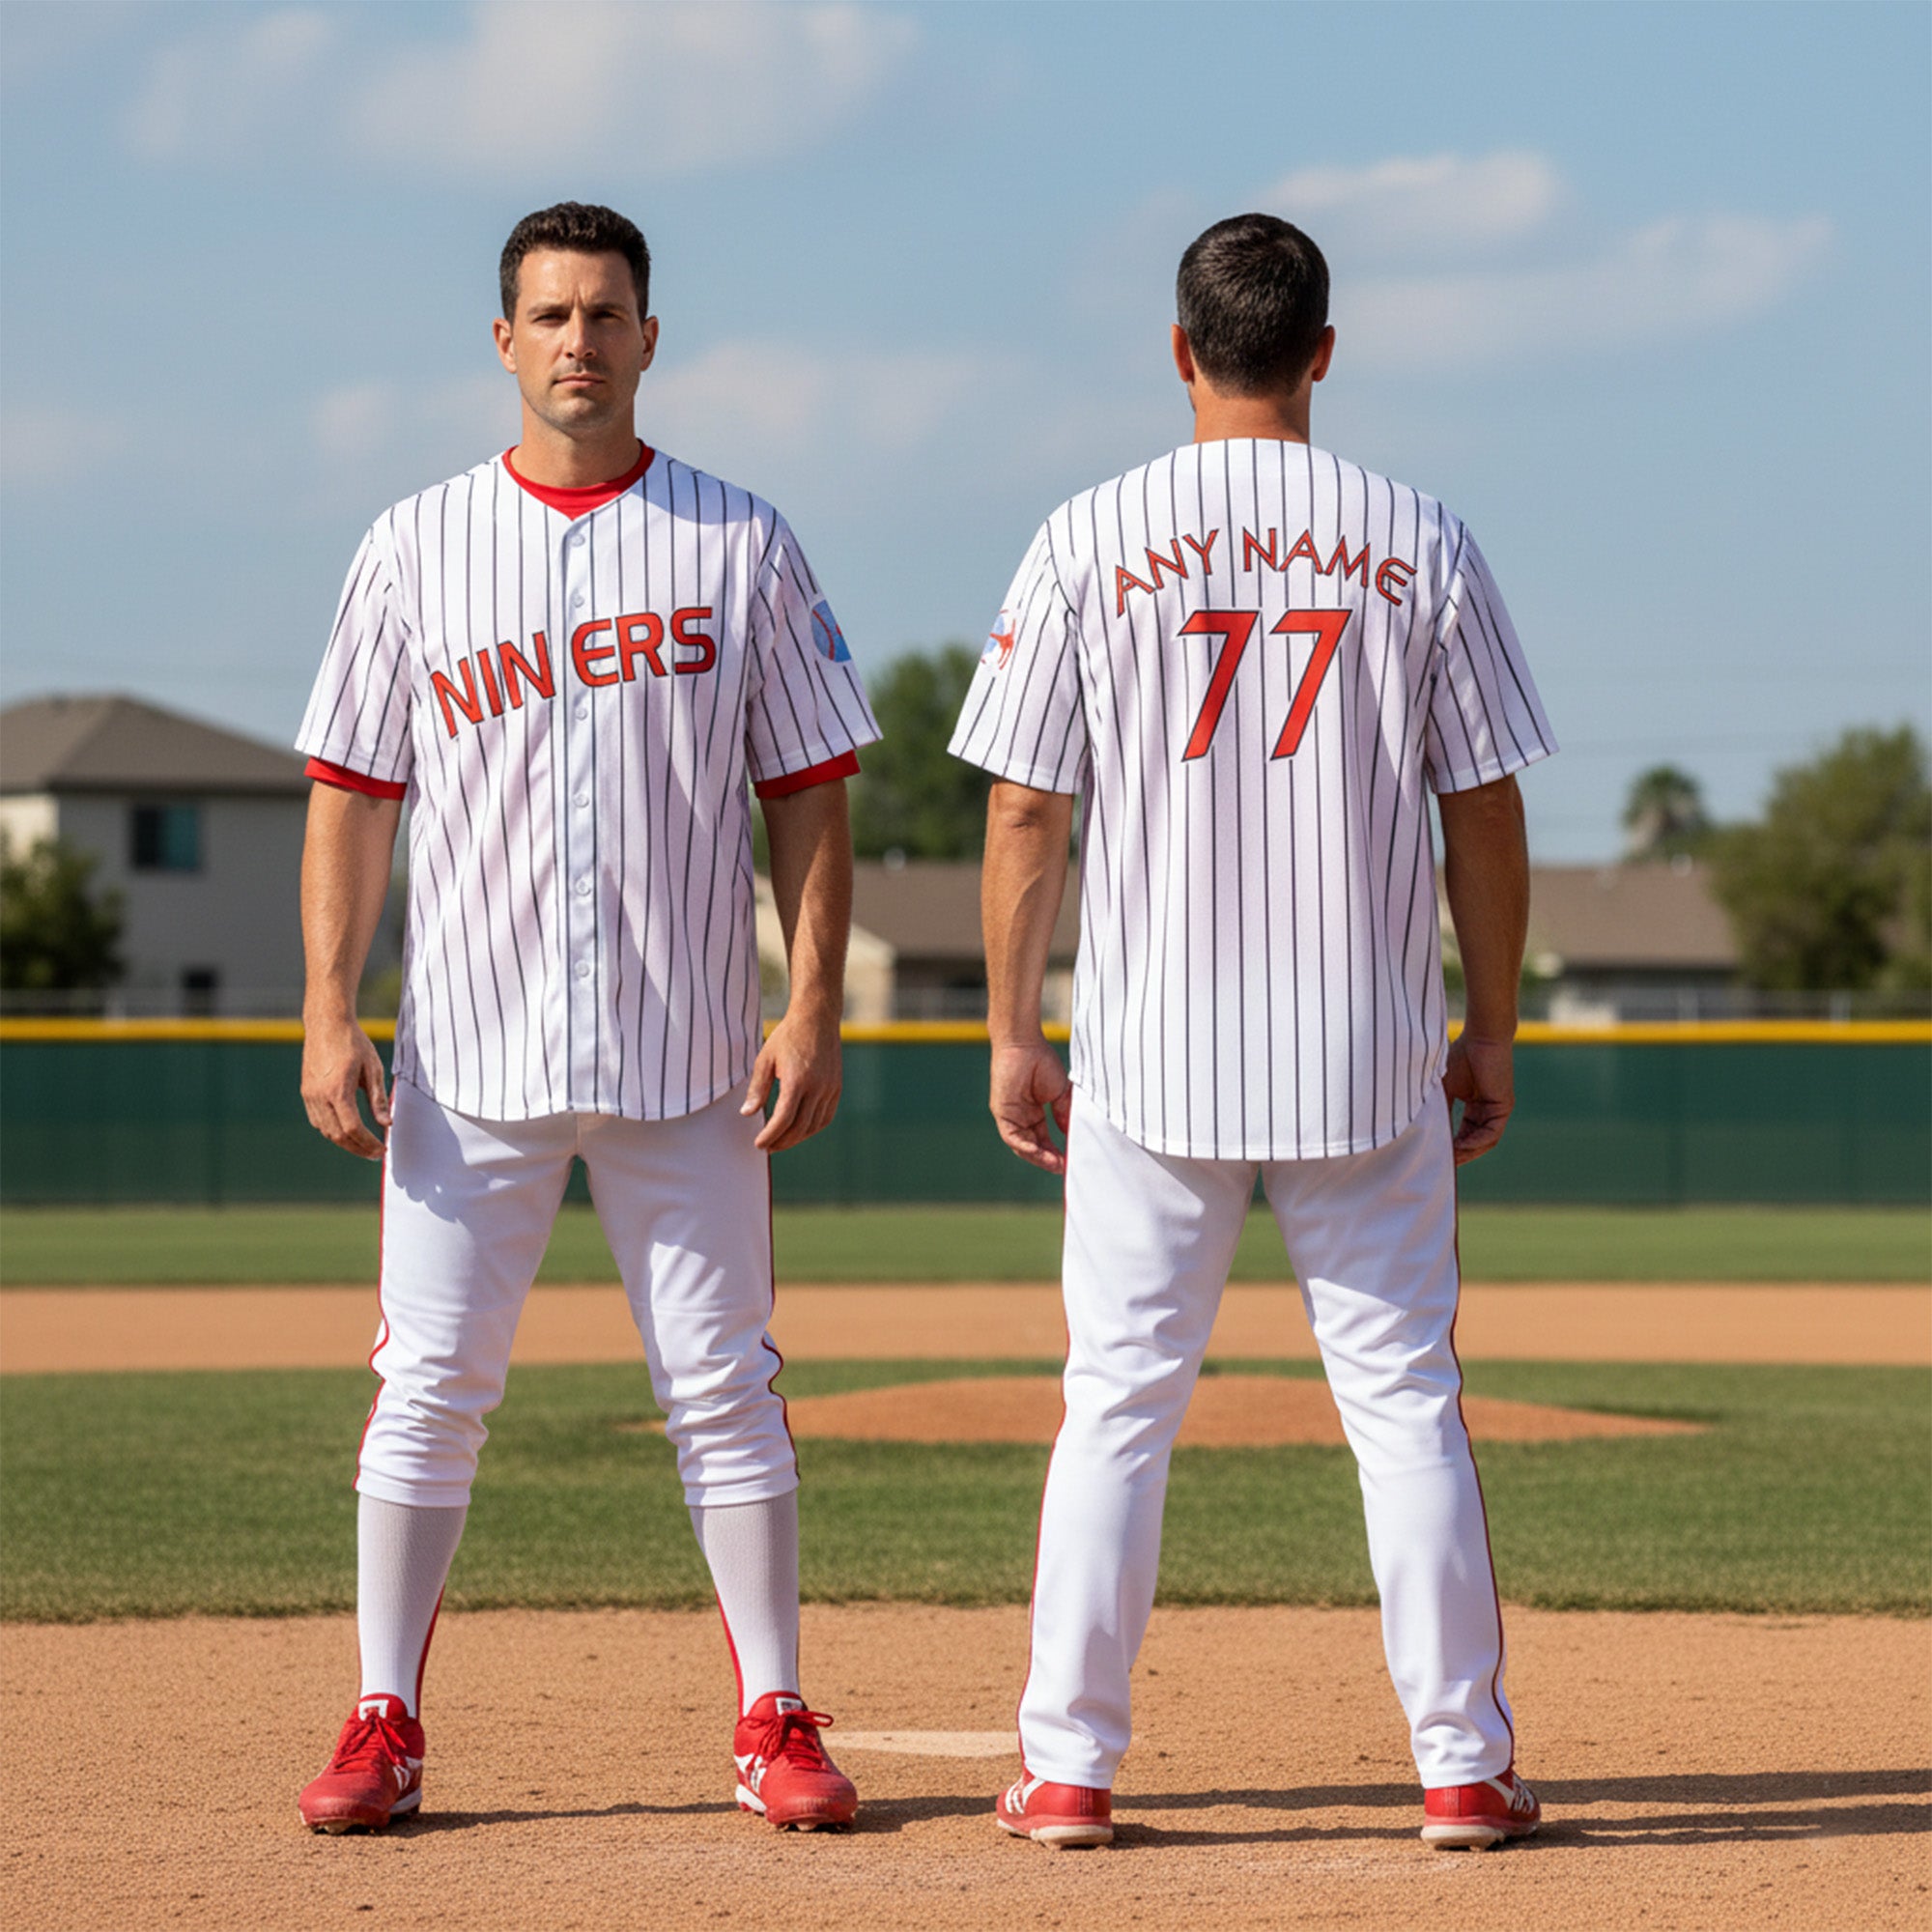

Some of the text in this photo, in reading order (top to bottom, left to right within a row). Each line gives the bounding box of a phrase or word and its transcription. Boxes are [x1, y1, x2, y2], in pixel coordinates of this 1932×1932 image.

[1115, 526, 1418, 618] ANY NAME
[429, 606, 718, 740] NINERS
[1177, 609, 1353, 763] 77
